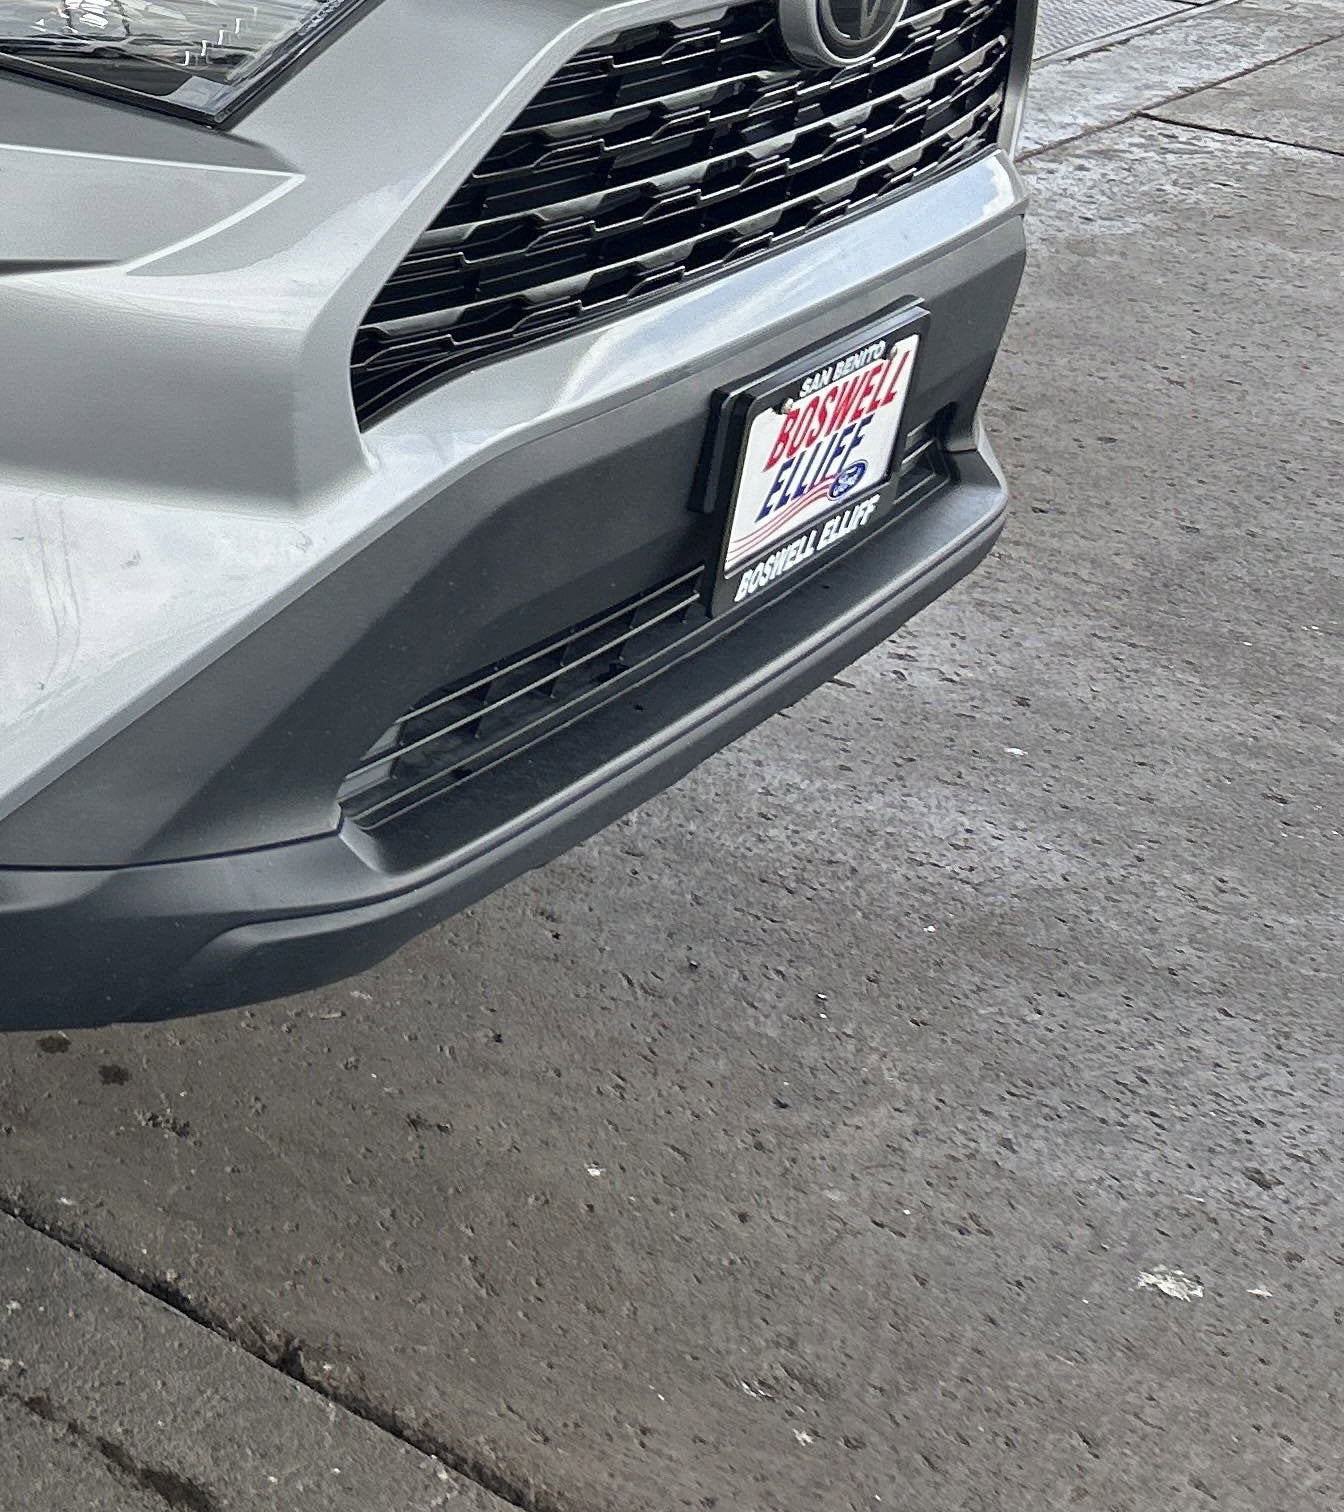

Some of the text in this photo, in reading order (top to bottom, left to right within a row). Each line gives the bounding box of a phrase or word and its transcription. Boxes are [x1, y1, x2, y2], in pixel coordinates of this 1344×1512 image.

[763, 351, 911, 472] BOSWELL
[800, 340, 887, 398] SAN BENITO
[754, 414, 875, 523] ELLIFF
[734, 494, 880, 602] BOSWELL ELLIFF
